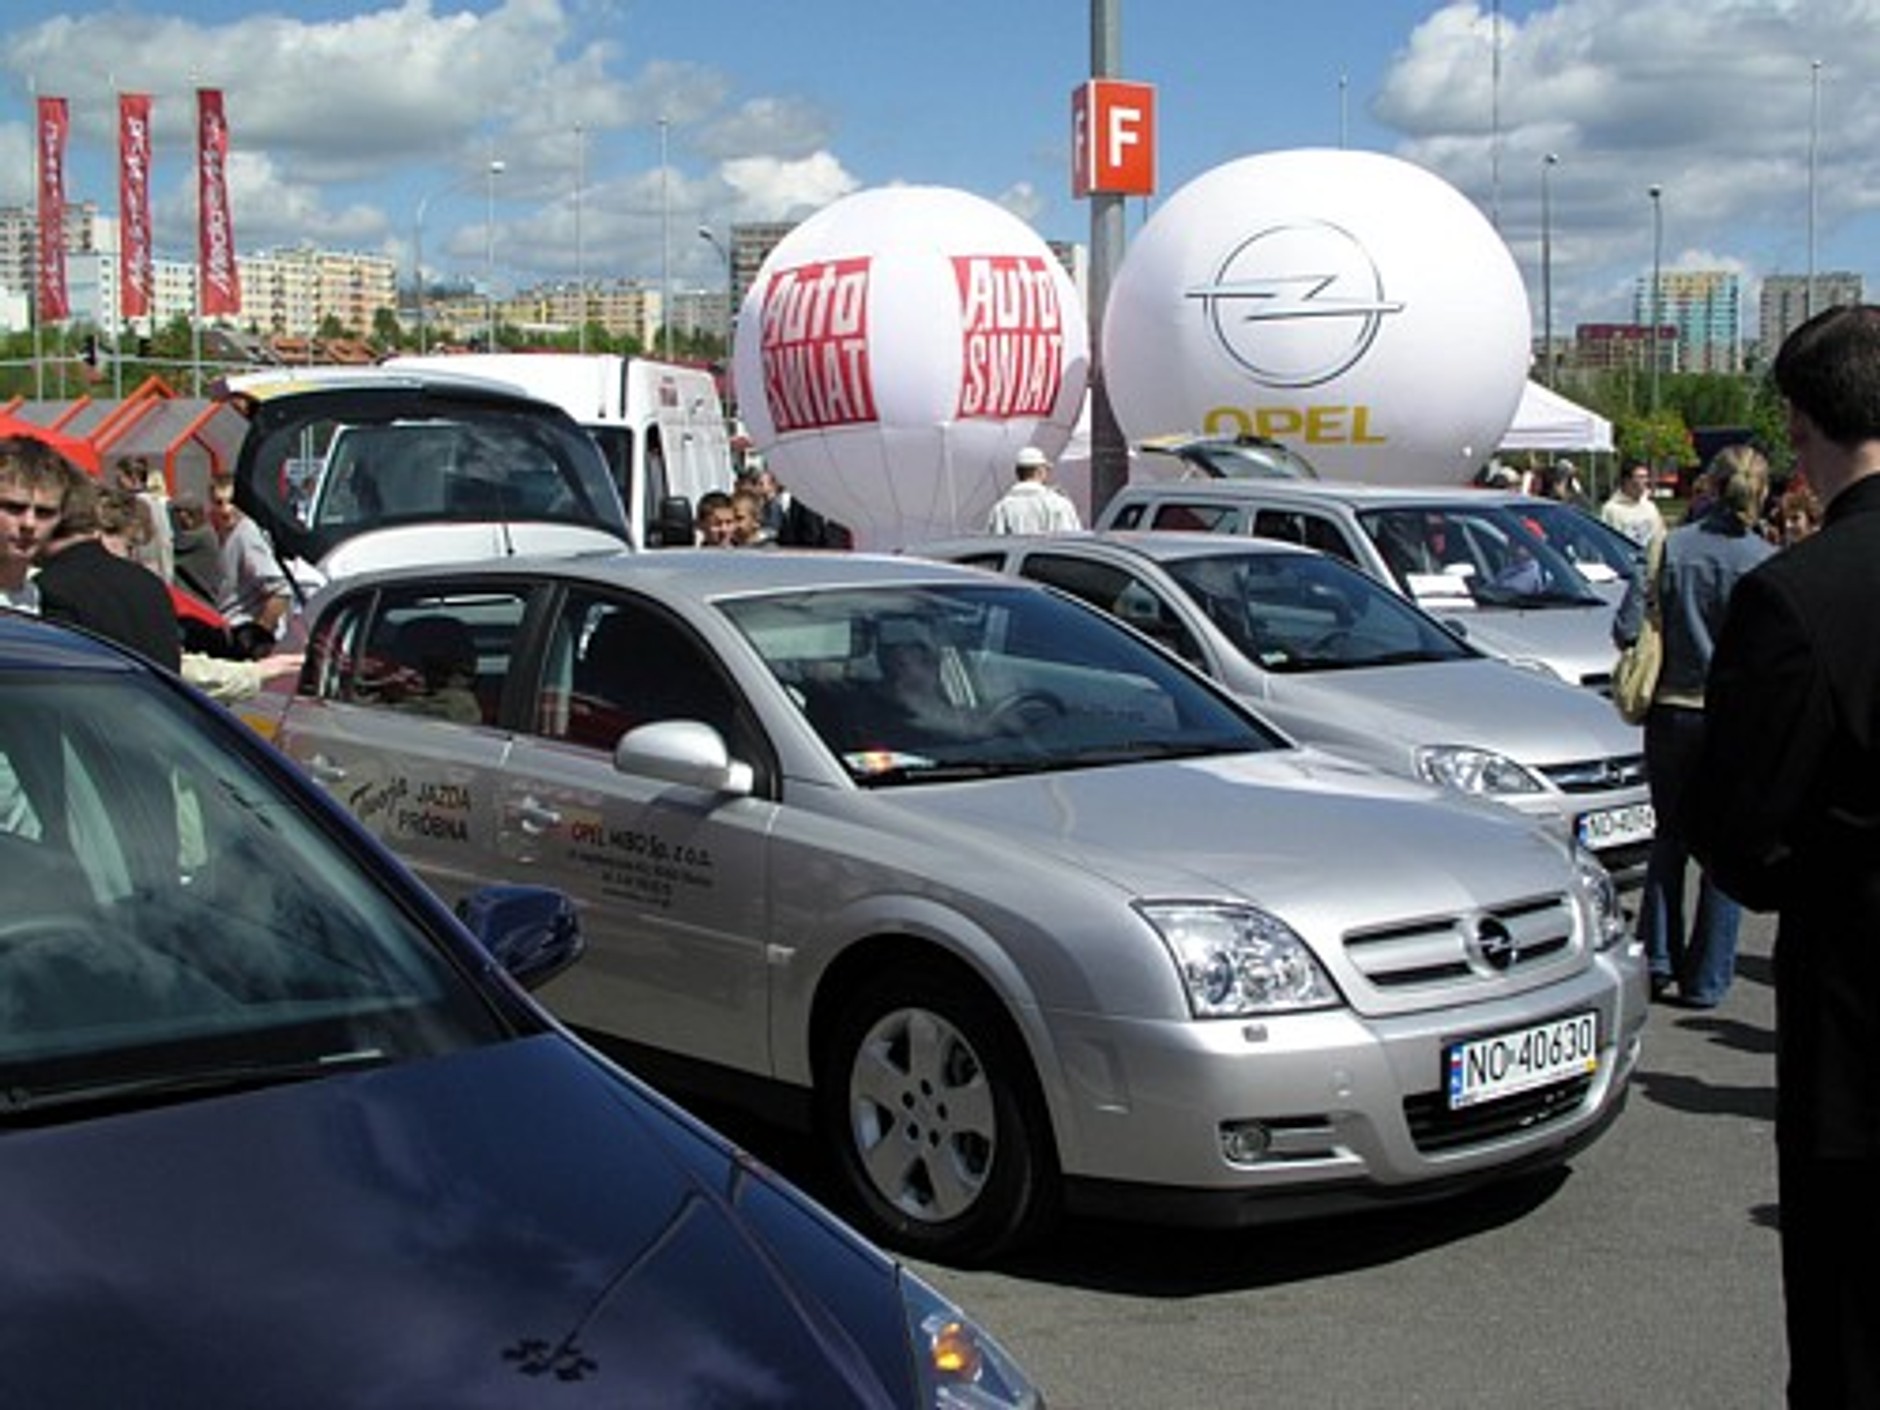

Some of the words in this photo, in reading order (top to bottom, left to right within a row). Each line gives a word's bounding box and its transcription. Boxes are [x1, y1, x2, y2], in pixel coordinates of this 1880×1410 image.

[1108, 105, 1141, 167] F
[763, 265, 868, 347] Auto
[962, 259, 1059, 331] Auto
[1203, 405, 1387, 445] OPEL
[417, 782, 471, 812] JAZDA
[1467, 1041, 1509, 1088] NO
[1519, 1019, 1592, 1073] 40630
